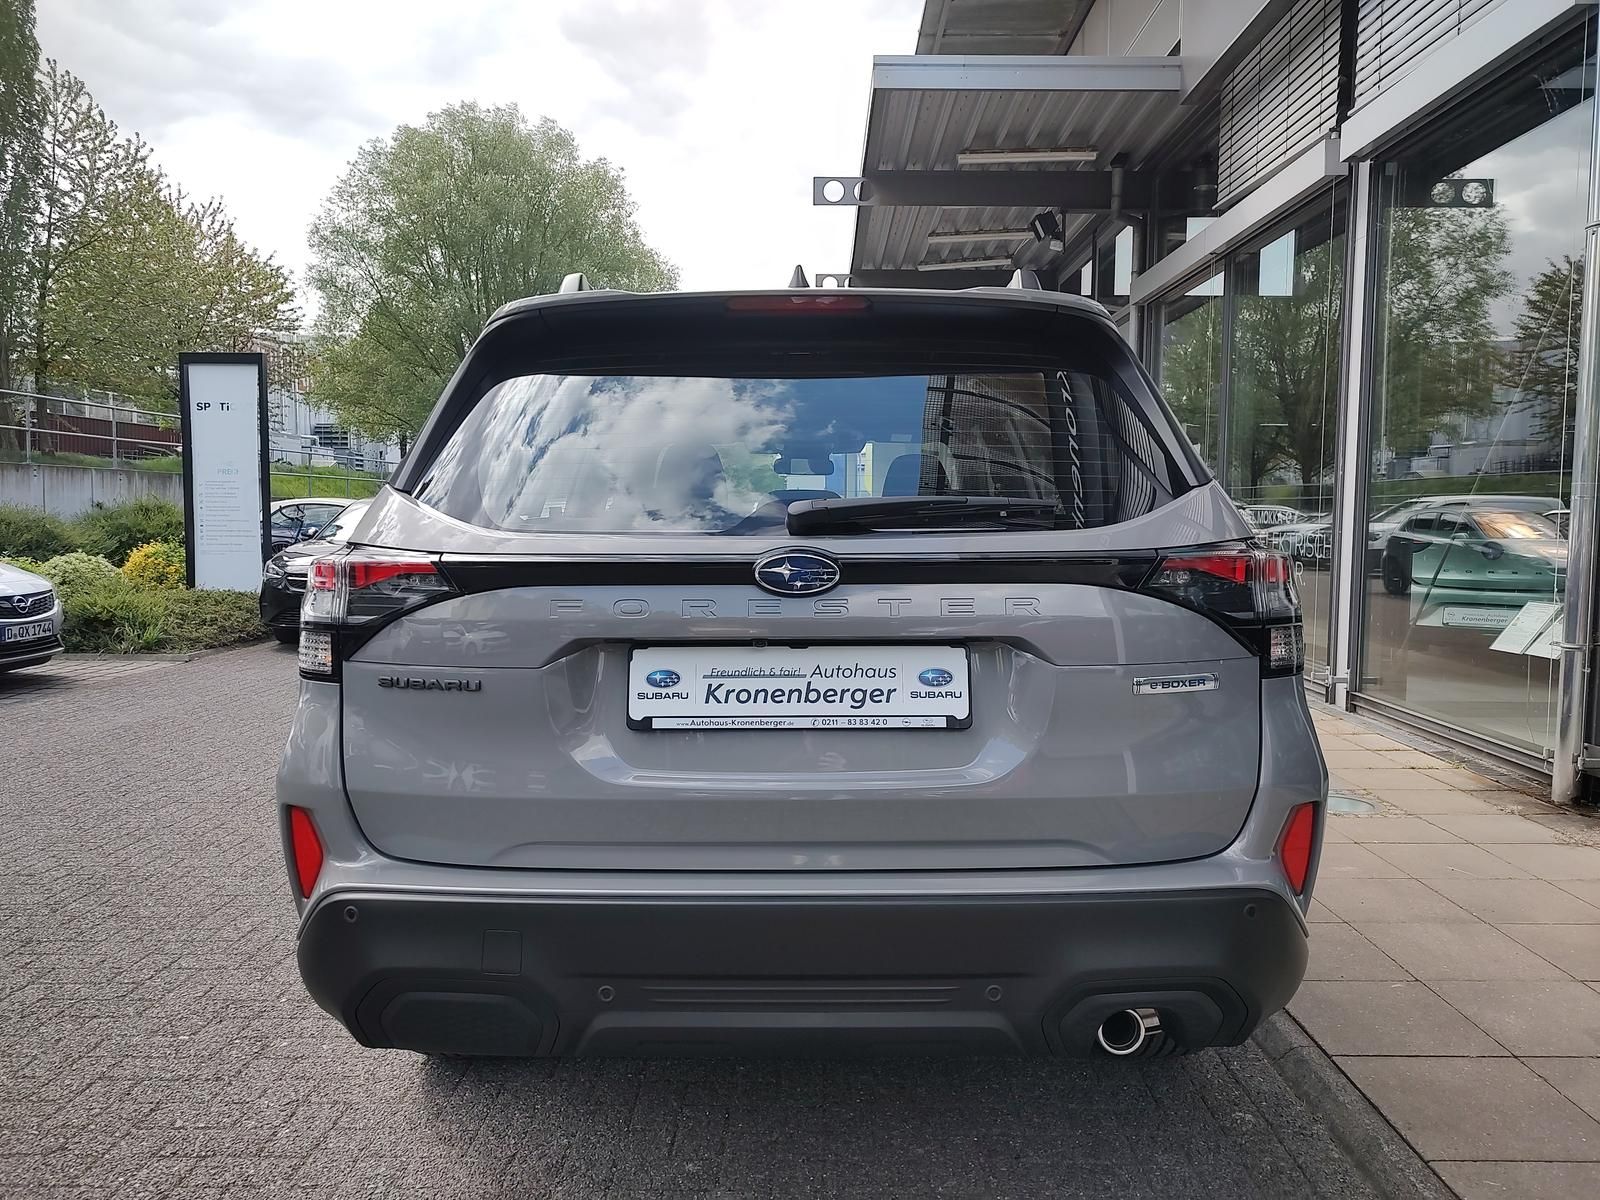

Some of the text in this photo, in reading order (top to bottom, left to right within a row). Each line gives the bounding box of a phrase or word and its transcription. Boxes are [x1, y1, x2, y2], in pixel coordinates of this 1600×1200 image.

[548, 597, 1042, 619] FORESTER
[710, 667, 801, 677] Freundlich & fair!
[810, 662, 897, 679] Autohaus
[378, 675, 482, 692] SUBARU
[1149, 678, 1207, 690] e-BOXER
[637, 692, 689, 700] SUBARU
[704, 681, 897, 710] Kronenberger
[910, 691, 962, 699] SUBARU
[676, 719, 795, 728] www.Autohaus-Kronenberger.de
[821, 718, 838, 726] 0211
[847, 718, 857, 726] 83
[859, 718, 869, 726] 83
[871, 718, 881, 726] 42
